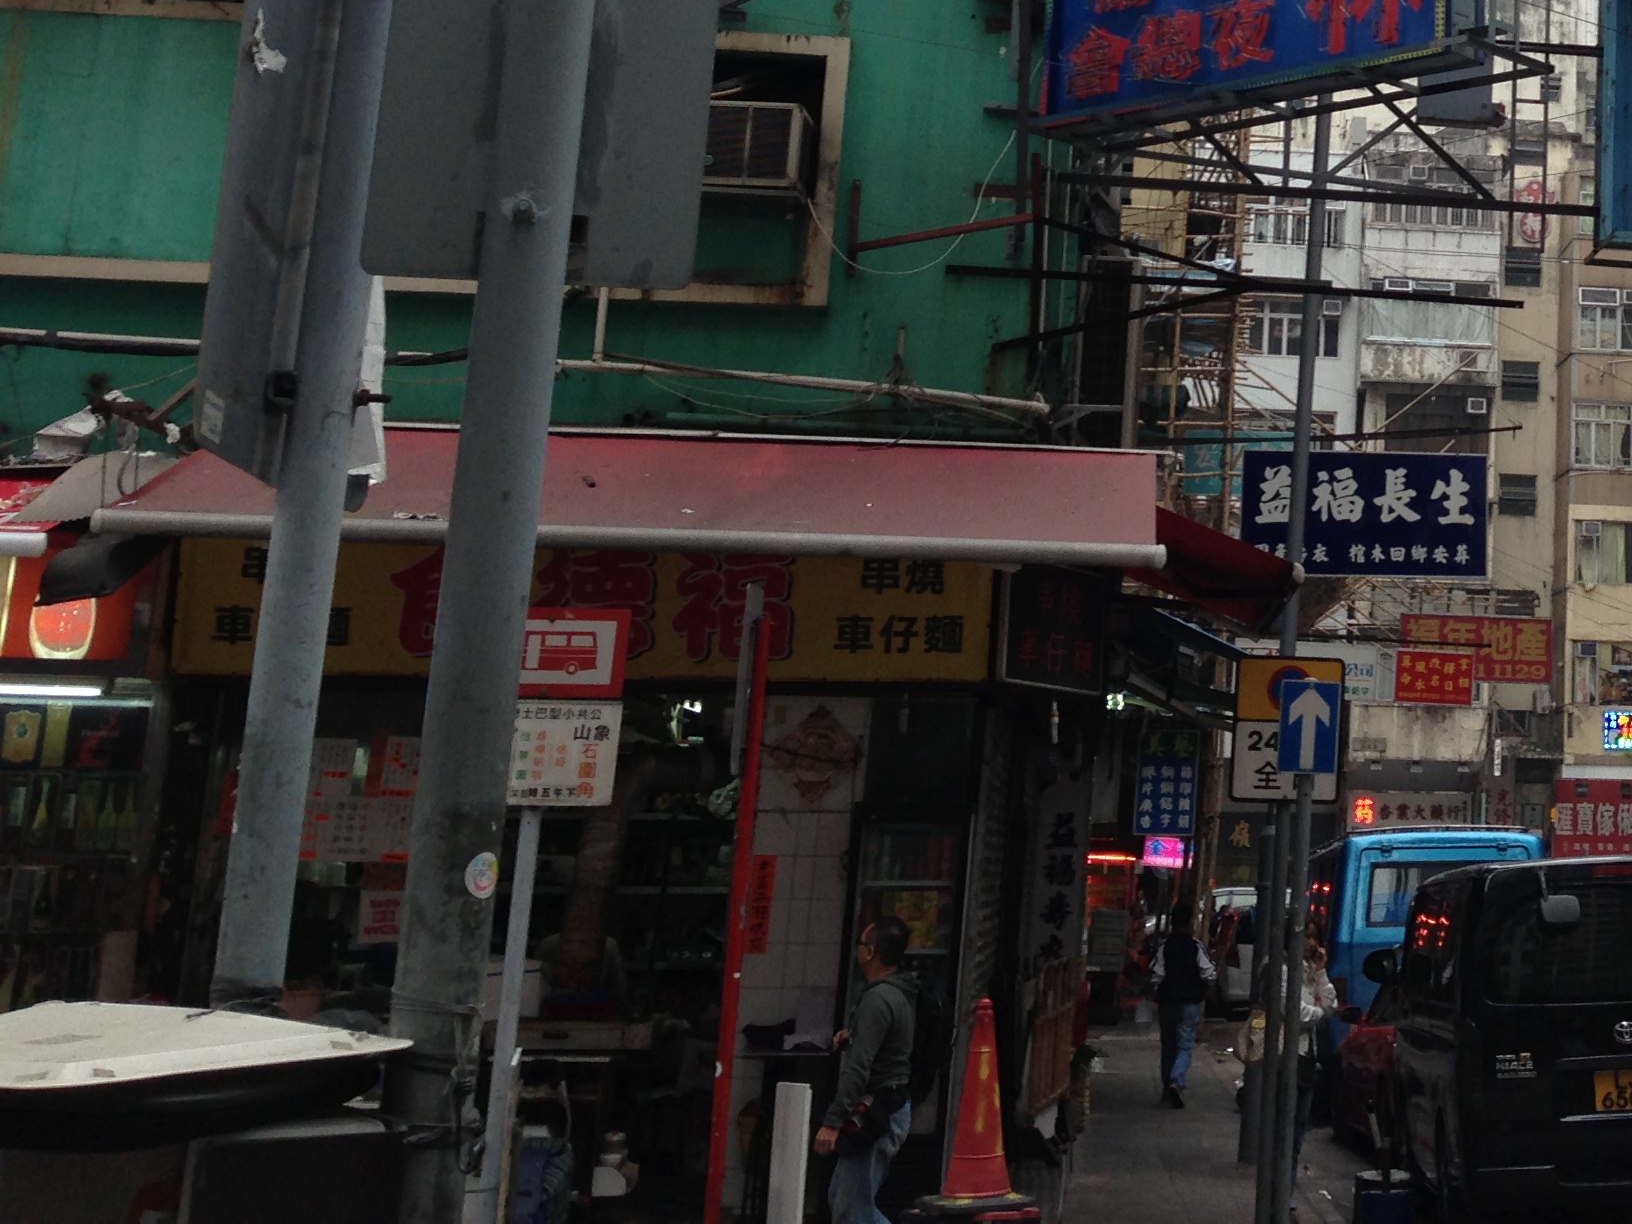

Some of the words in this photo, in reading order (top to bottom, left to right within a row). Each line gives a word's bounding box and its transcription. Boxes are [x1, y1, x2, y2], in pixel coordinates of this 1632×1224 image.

[832, 614, 965, 656] 車仔麵
[1491, 663, 1546, 680] 1129
[517, 707, 602, 721] 公共小型巴士
